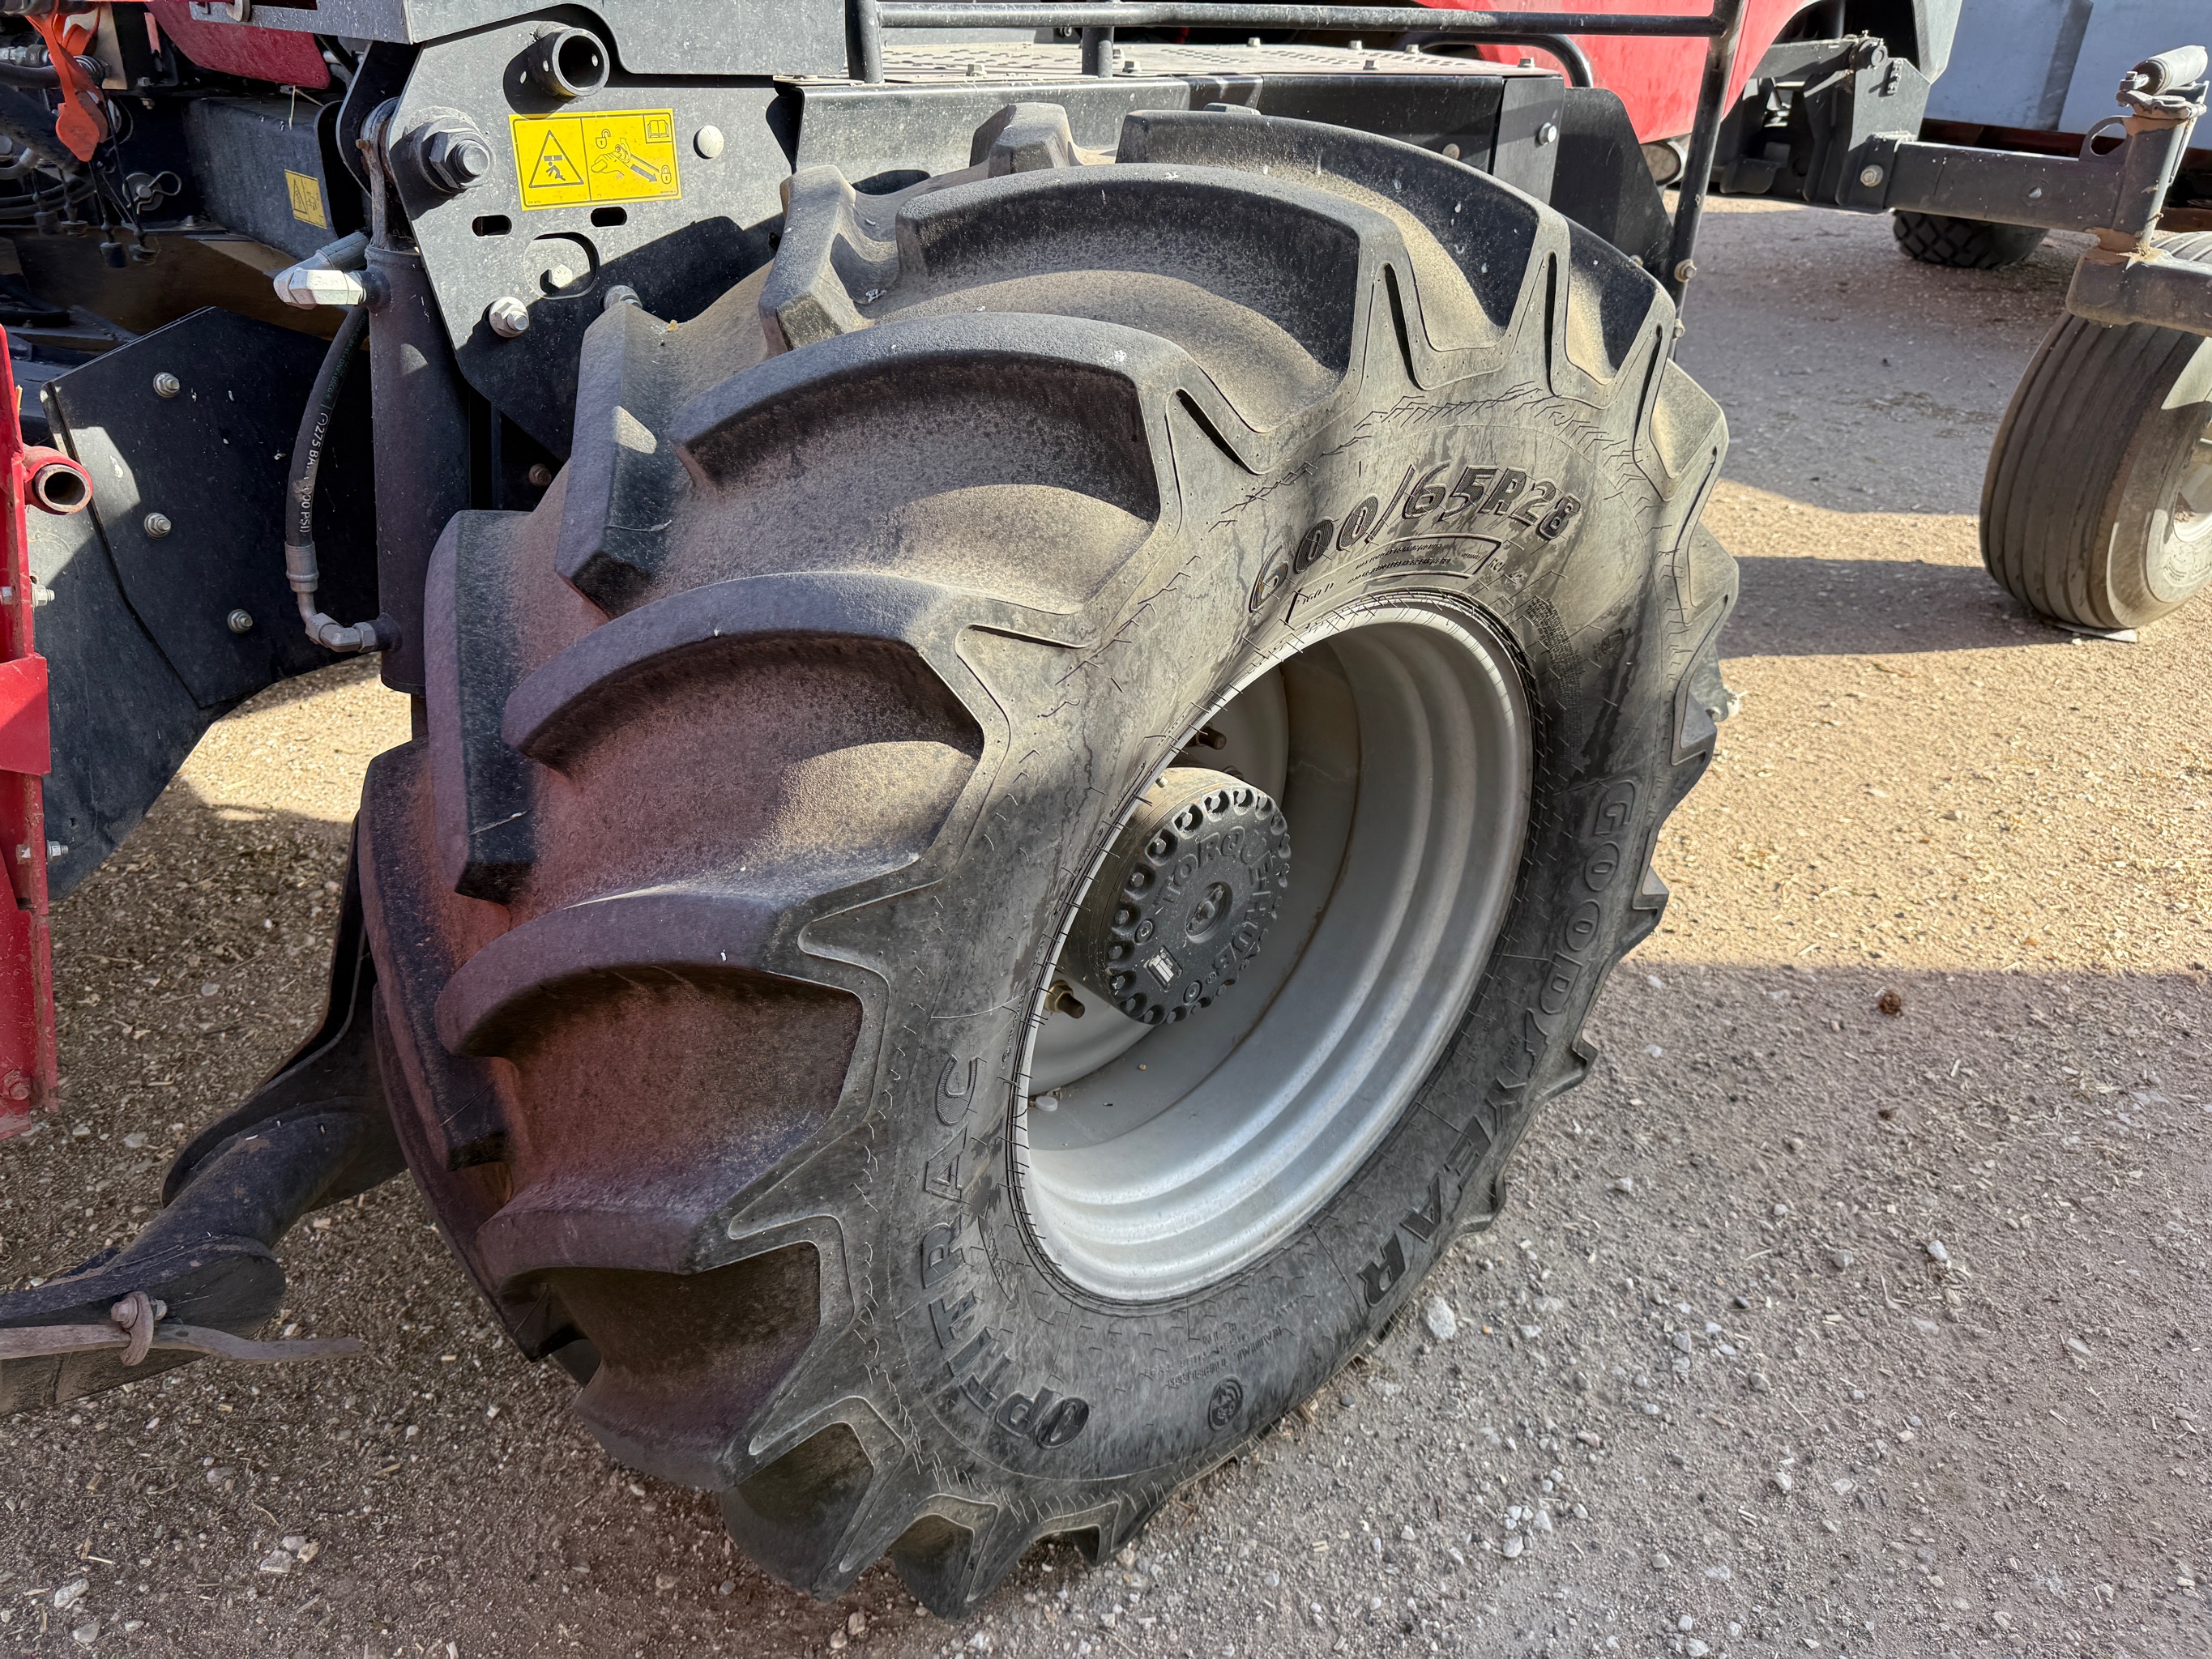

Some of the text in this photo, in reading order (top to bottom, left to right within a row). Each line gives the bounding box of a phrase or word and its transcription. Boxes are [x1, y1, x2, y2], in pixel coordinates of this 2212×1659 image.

[306, 450, 319, 470] BA
[311, 425, 325, 448] 275
[1249, 462, 1582, 614] 600/65R28
[920, 1056, 1091, 1450] OPTITRAC
